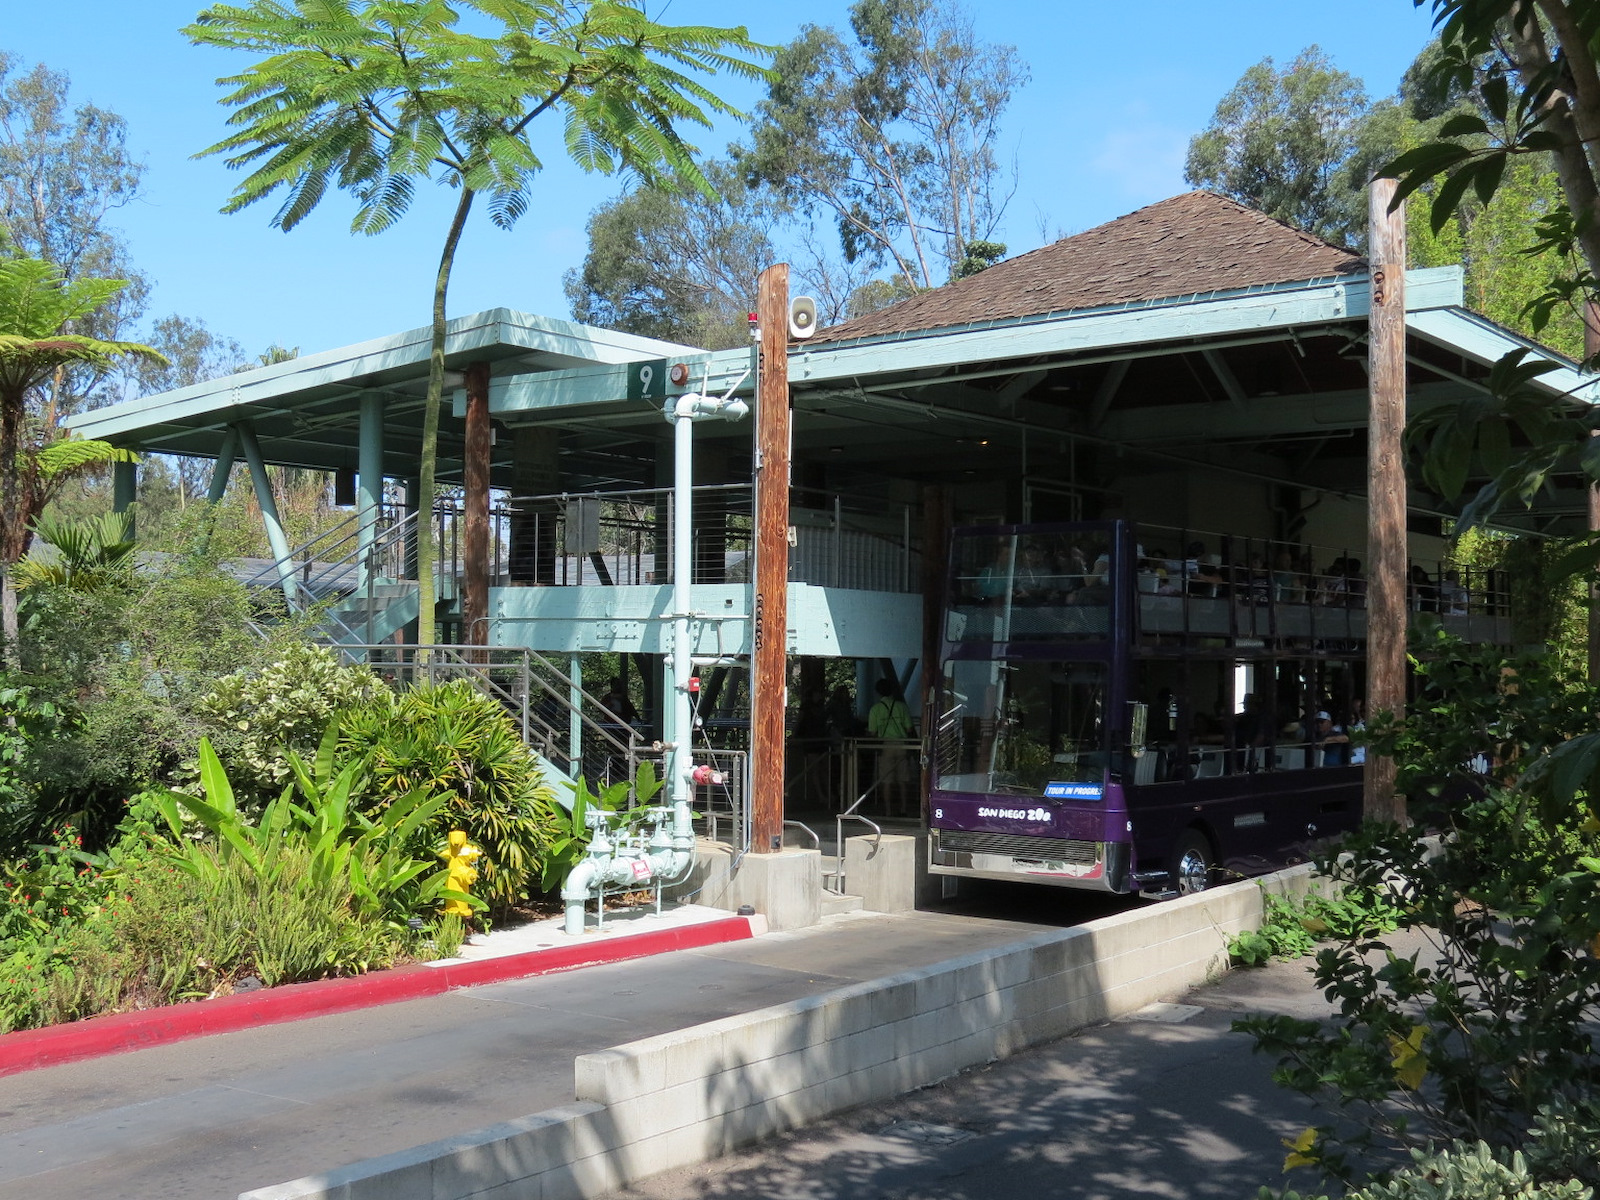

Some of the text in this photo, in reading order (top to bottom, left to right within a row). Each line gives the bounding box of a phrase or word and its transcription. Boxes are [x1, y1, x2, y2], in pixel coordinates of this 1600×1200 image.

[639, 365, 653, 394] 9
[1048, 787, 1065, 795] TOUR
[1065, 787, 1074, 795] IN
[935, 808, 943, 819] 8
[977, 807, 998, 817] SAN
[998, 808, 1025, 820] DIEGO
[1126, 820, 1133, 832] 8
